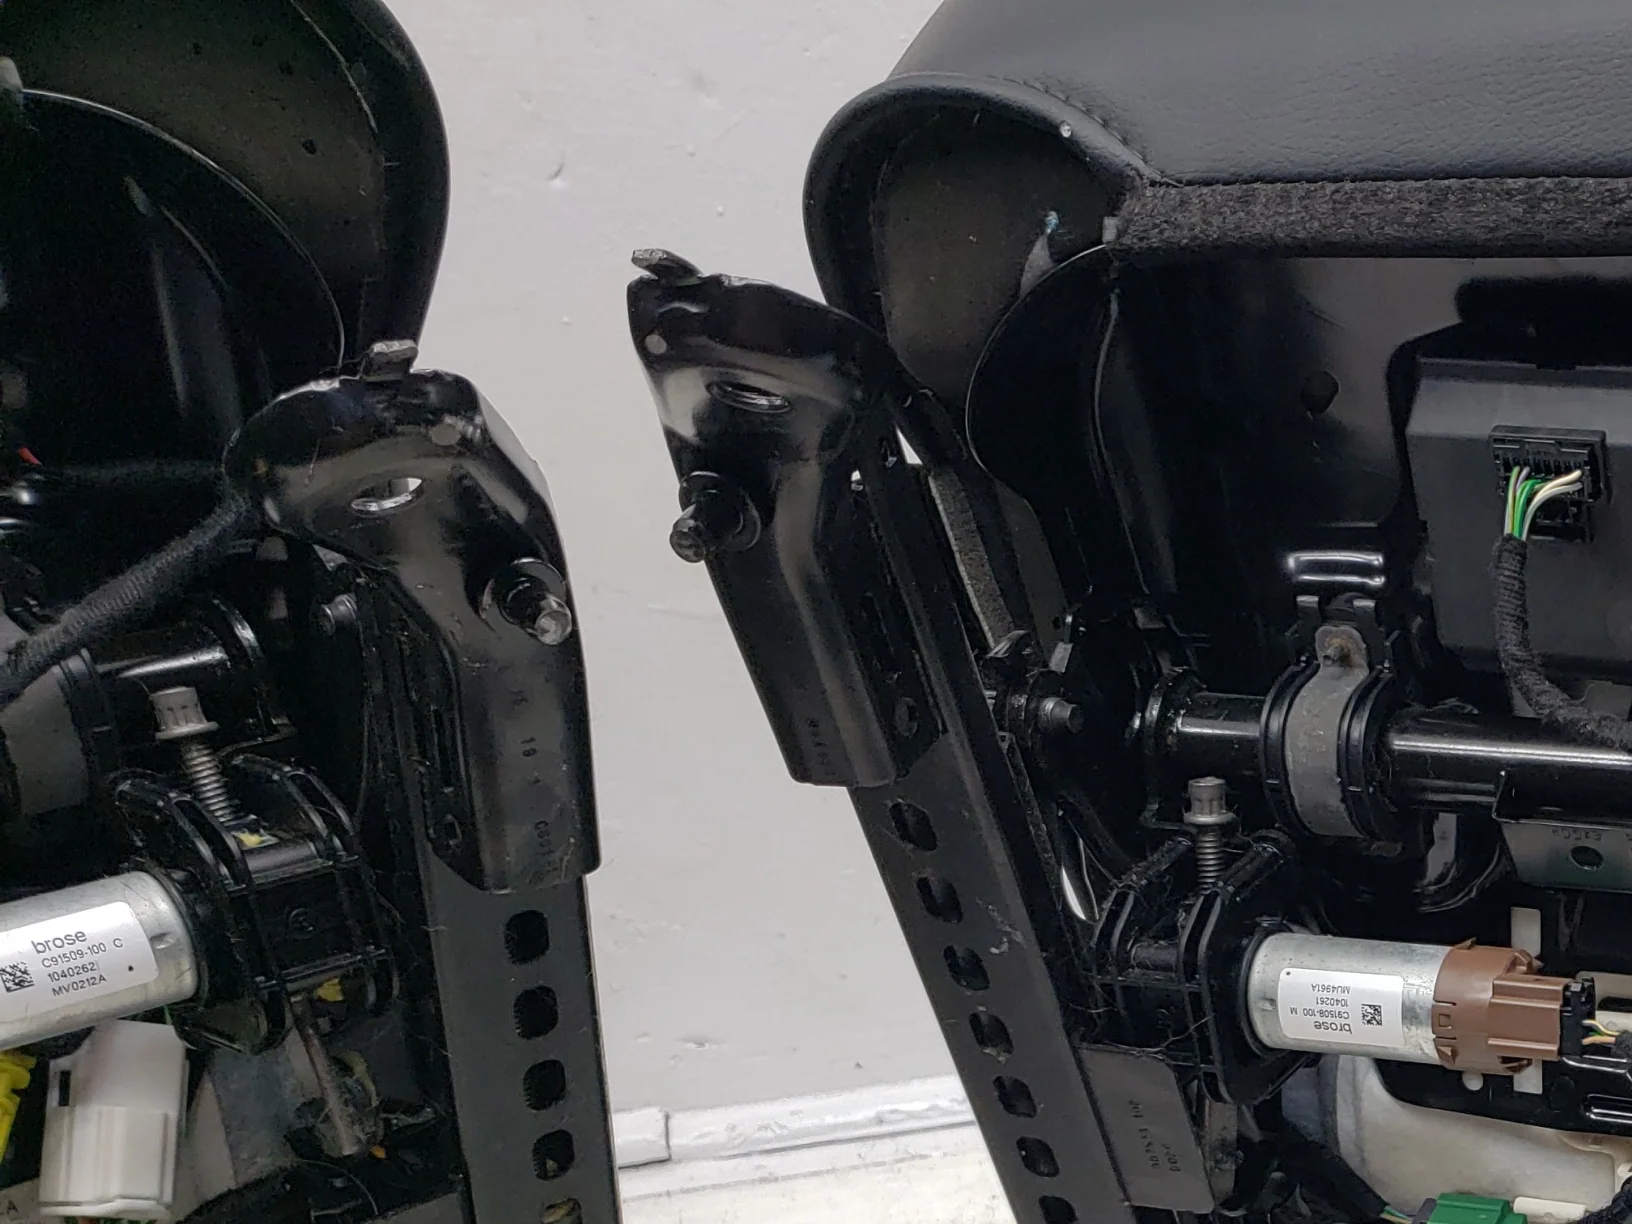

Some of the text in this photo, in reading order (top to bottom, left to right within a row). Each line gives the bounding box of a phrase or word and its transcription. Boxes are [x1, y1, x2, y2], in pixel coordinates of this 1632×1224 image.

[31, 930, 88, 955] brose
[42, 937, 124, 968] C91509-100 C
[47, 961, 98, 983] 1040262
[51, 974, 108, 997] MV0212A
[1311, 983, 1351, 995] MU4961A
[1289, 1006, 1298, 1016] M
[1315, 996, 1349, 1008] 1040261
[1313, 1020, 1353, 1035] brose
